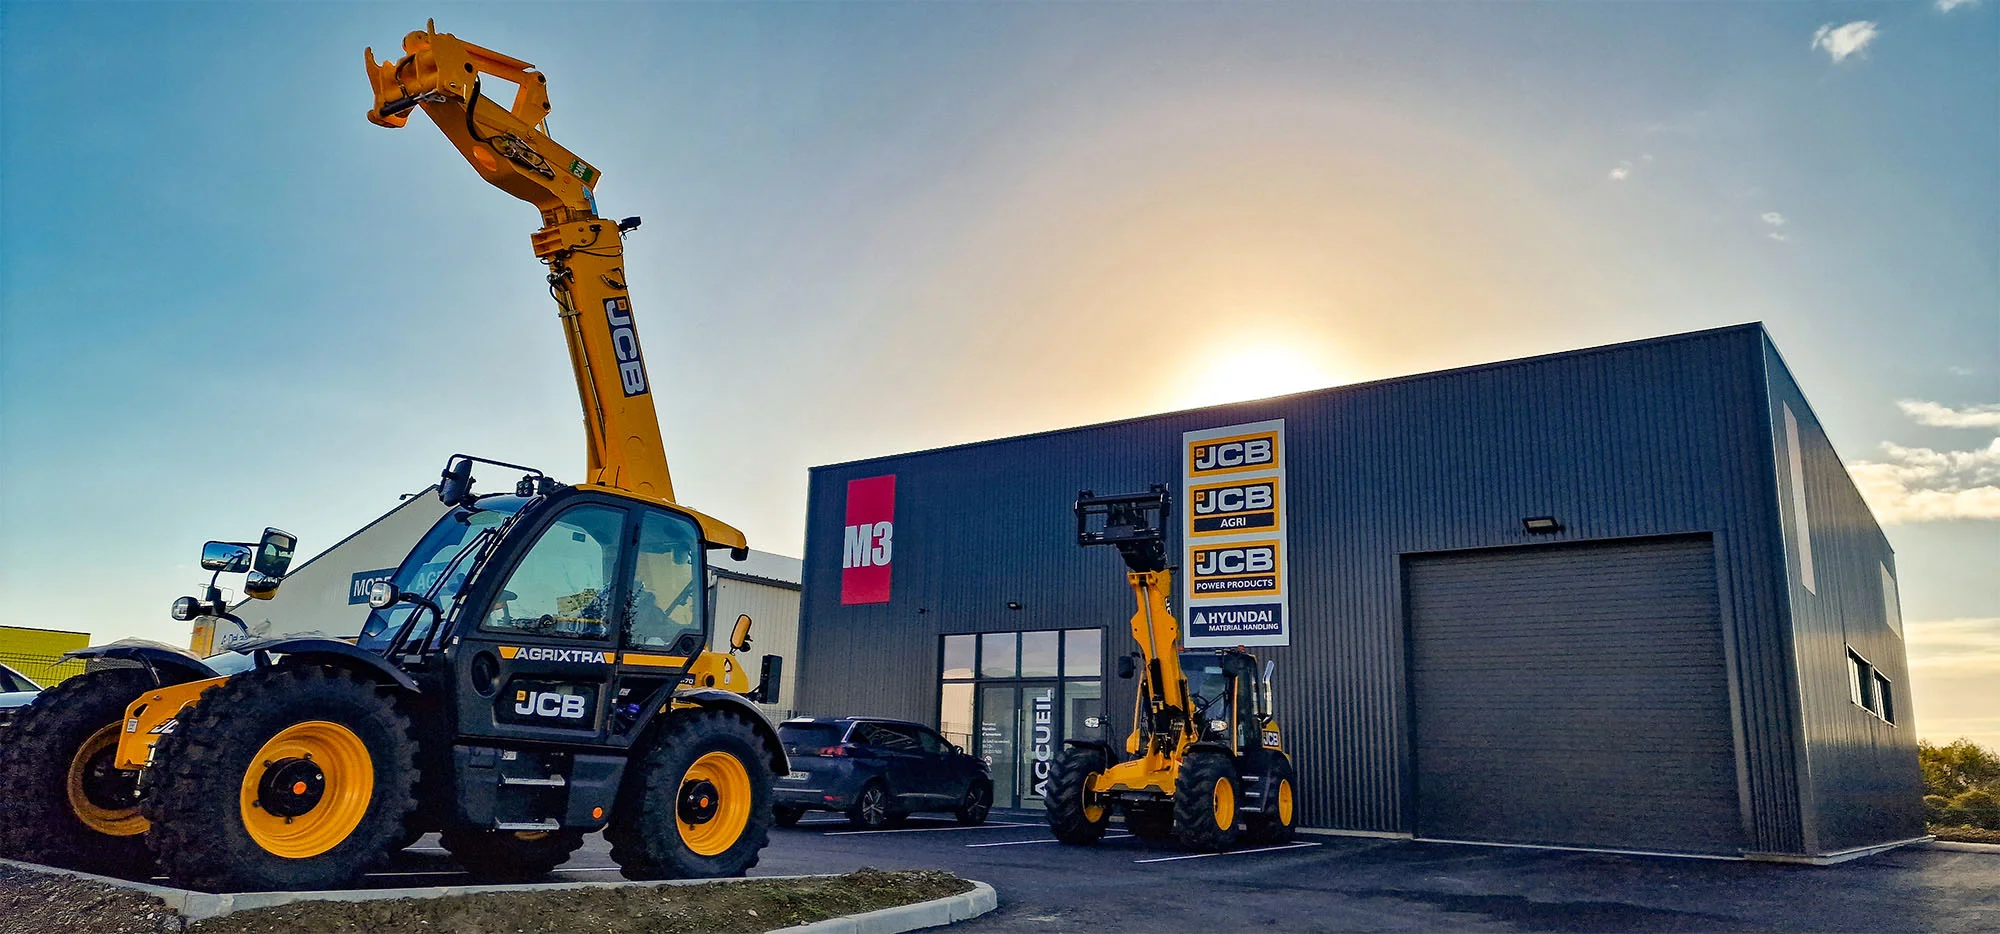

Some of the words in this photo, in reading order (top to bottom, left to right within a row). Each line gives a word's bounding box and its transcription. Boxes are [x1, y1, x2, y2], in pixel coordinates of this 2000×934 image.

[606, 300, 645, 394] JCB
[1196, 440, 1271, 469] JCB
[1196, 485, 1272, 514] JCB
[1220, 517, 1246, 528] AGRI
[843, 521, 893, 569] M3
[1196, 548, 1273, 575] JCB
[1196, 582, 1226, 590] POWER
[1227, 579, 1273, 589] PRODUCTS
[1208, 610, 1272, 624] HYUNDAI
[1243, 623, 1279, 631] HANDLING
[515, 648, 605, 664] AGRIXTRA
[515, 691, 585, 719] JCB
[1035, 689, 1051, 798] ACCUEIL
[1264, 732, 1279, 746] JCB
